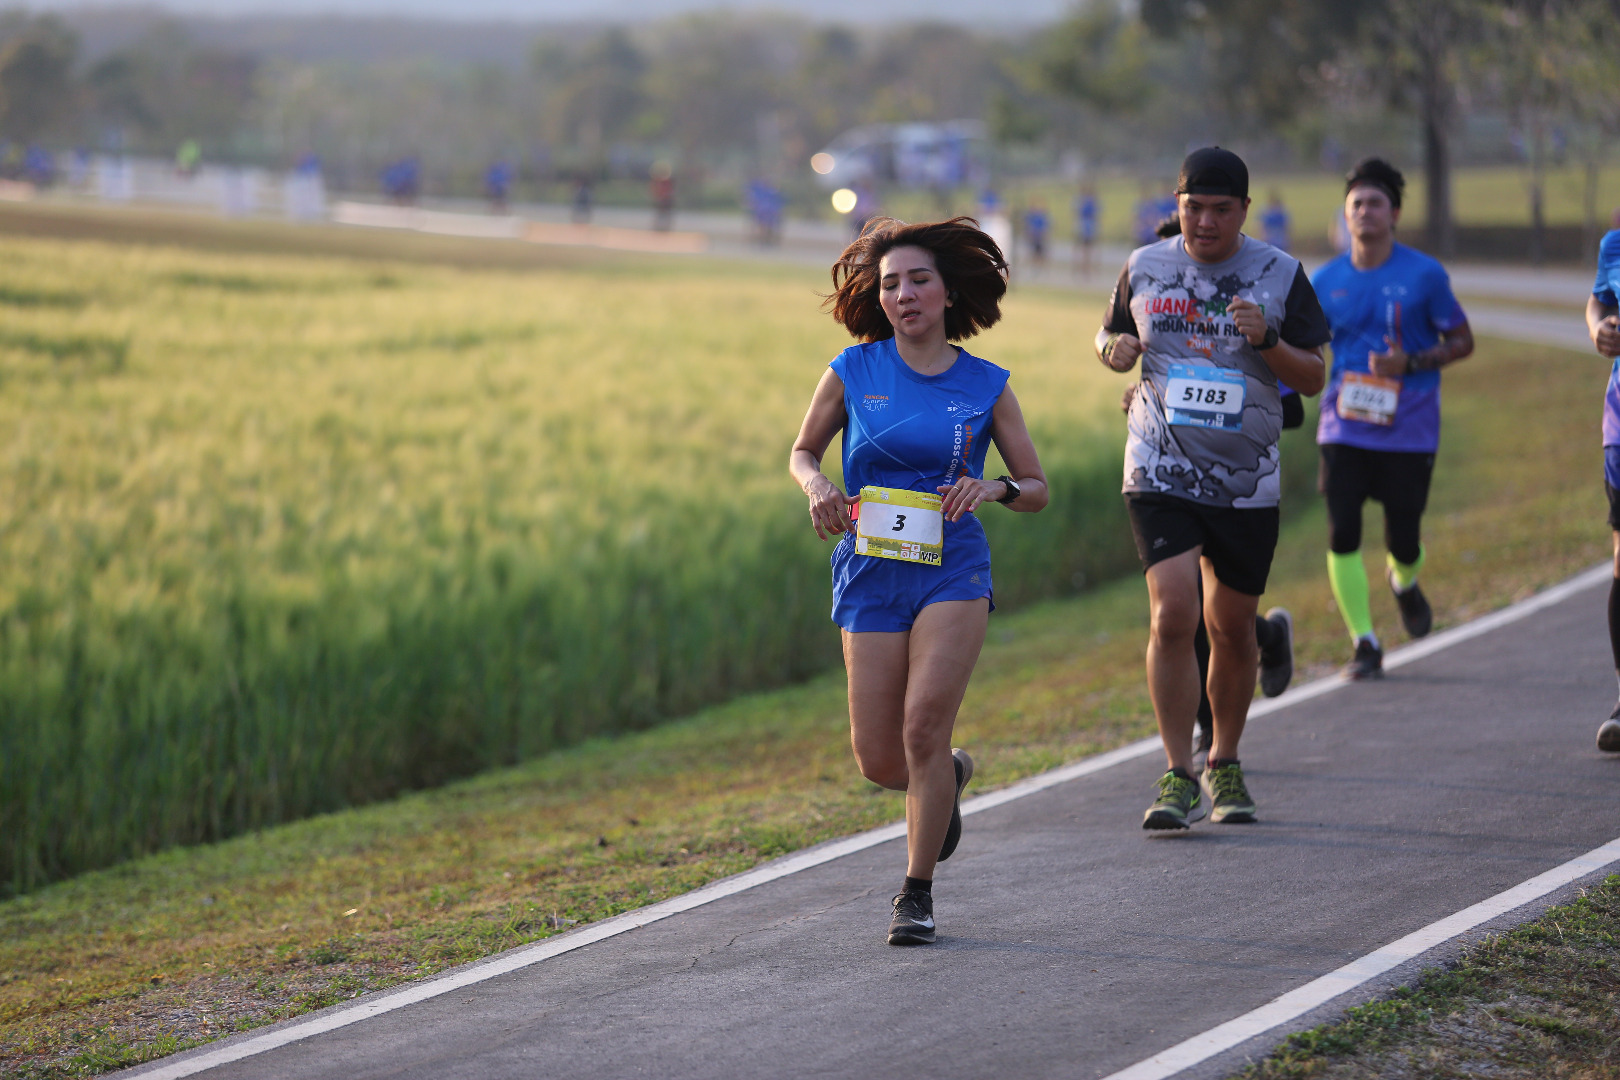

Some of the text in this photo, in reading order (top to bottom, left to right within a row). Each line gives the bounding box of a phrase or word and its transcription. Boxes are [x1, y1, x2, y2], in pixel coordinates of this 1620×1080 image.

[1145, 297, 1198, 316] LUANG
[1152, 320, 1246, 338] MOUNTAIN RU
[1182, 386, 1227, 405] 5183
[953, 423, 962, 457] CROSS
[892, 514, 907, 531] 3
